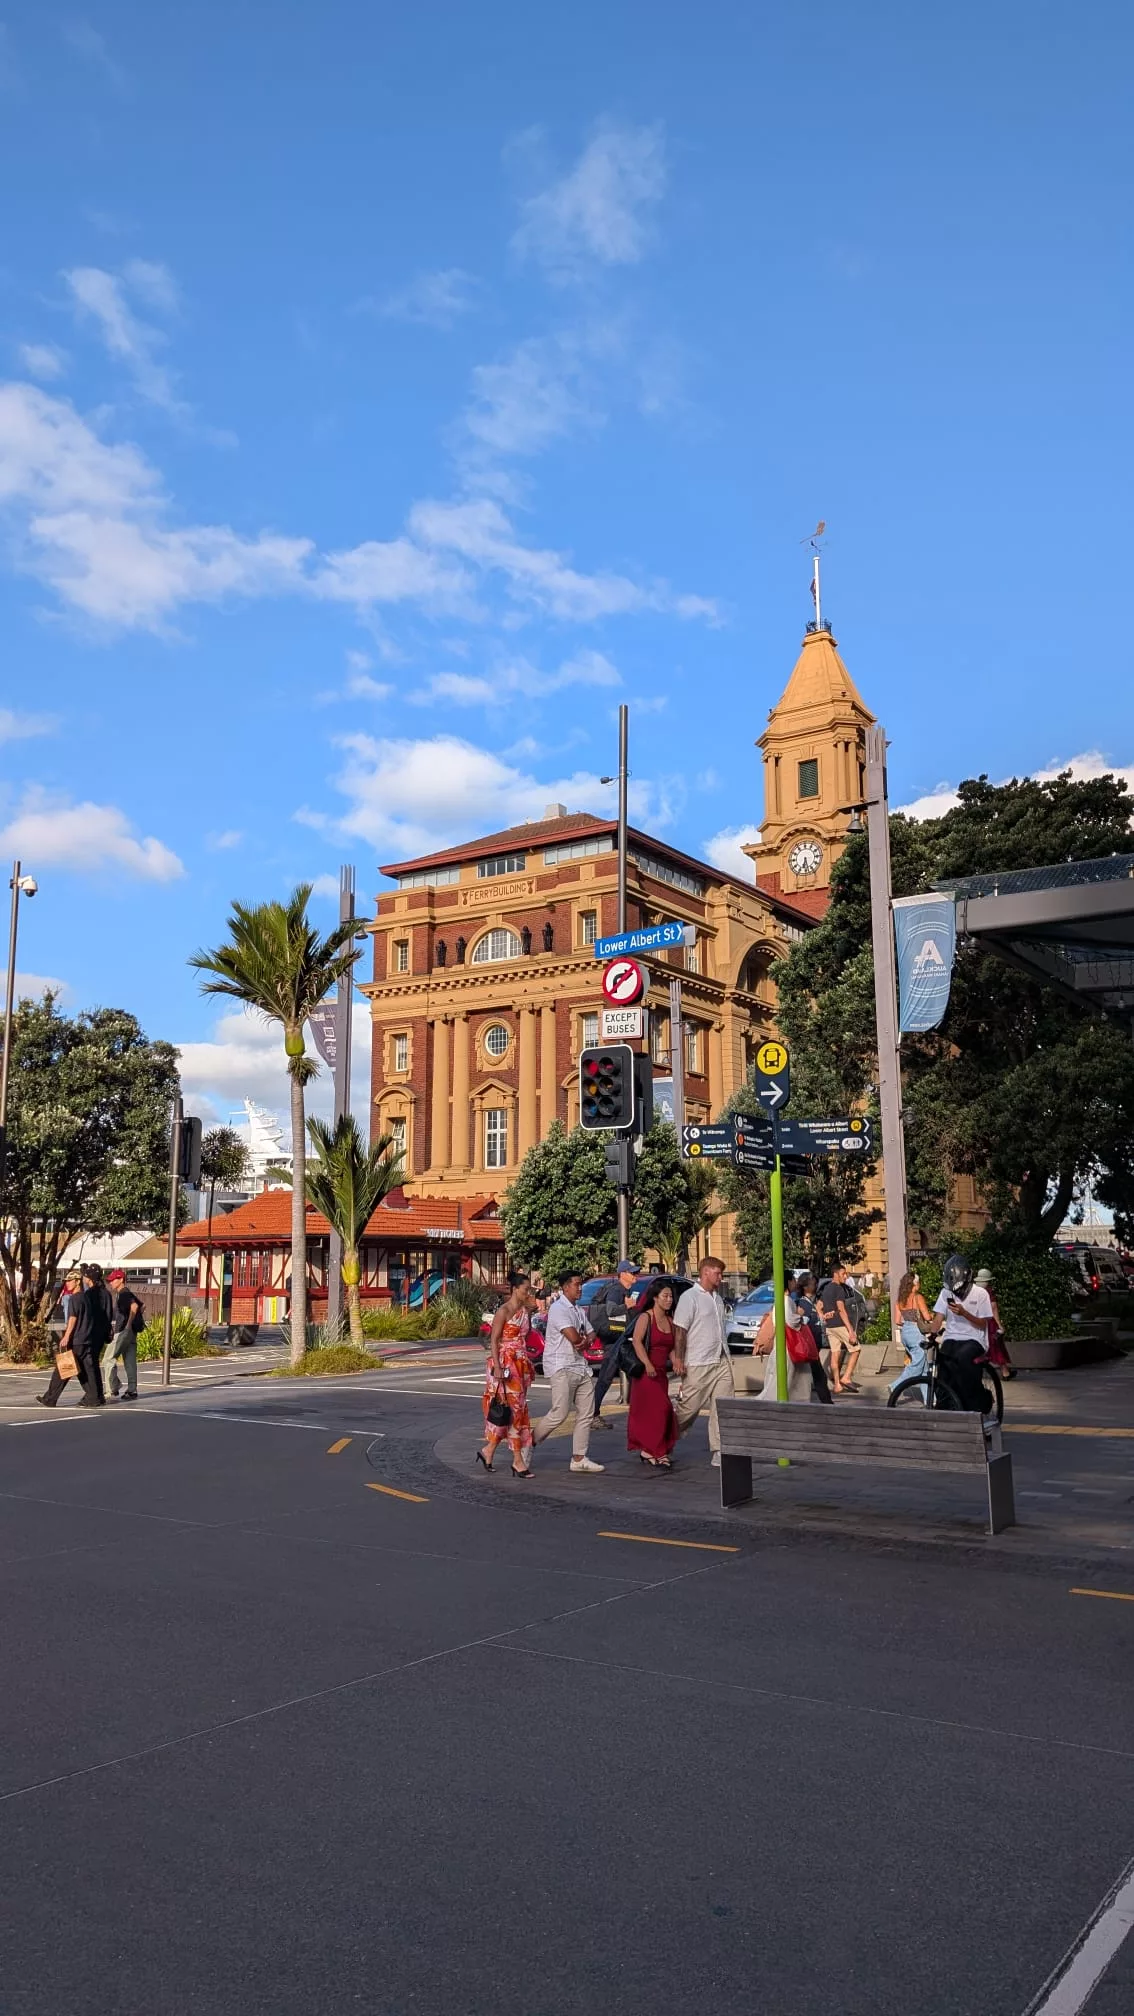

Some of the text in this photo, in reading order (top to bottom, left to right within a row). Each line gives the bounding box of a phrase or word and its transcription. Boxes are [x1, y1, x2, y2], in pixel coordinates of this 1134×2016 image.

[599, 928, 675, 954] Lower Albert St
[605, 1012, 638, 1023] EXCEPT
[607, 1024, 636, 1034] BUSES
